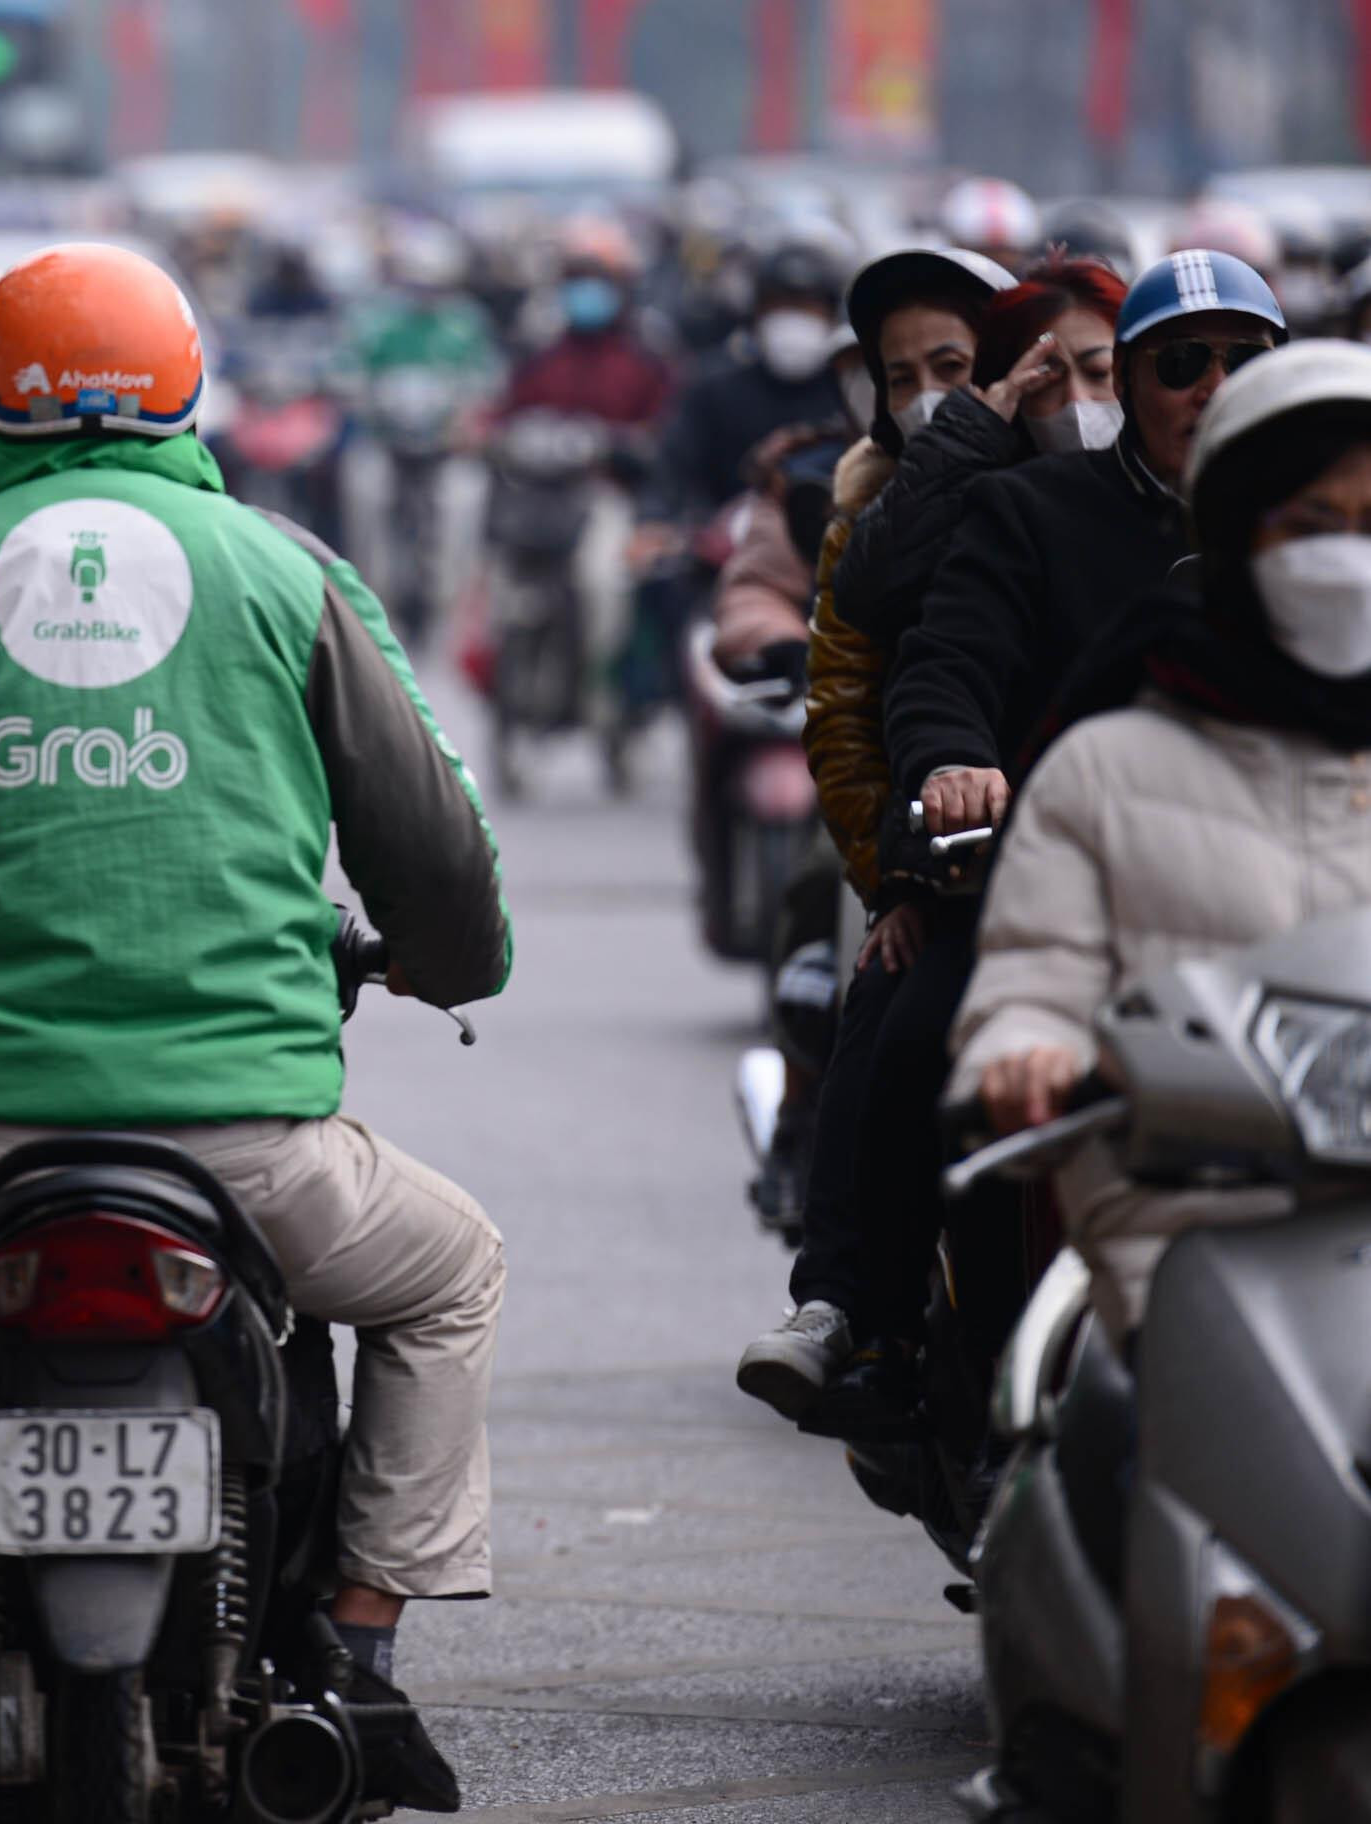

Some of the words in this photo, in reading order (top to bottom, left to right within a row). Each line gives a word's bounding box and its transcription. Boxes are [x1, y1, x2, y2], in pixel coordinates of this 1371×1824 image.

[58, 369, 155, 390] AhaMove
[32, 619, 141, 643] GrabBike
[20, 1486, 179, 1542] 3823
